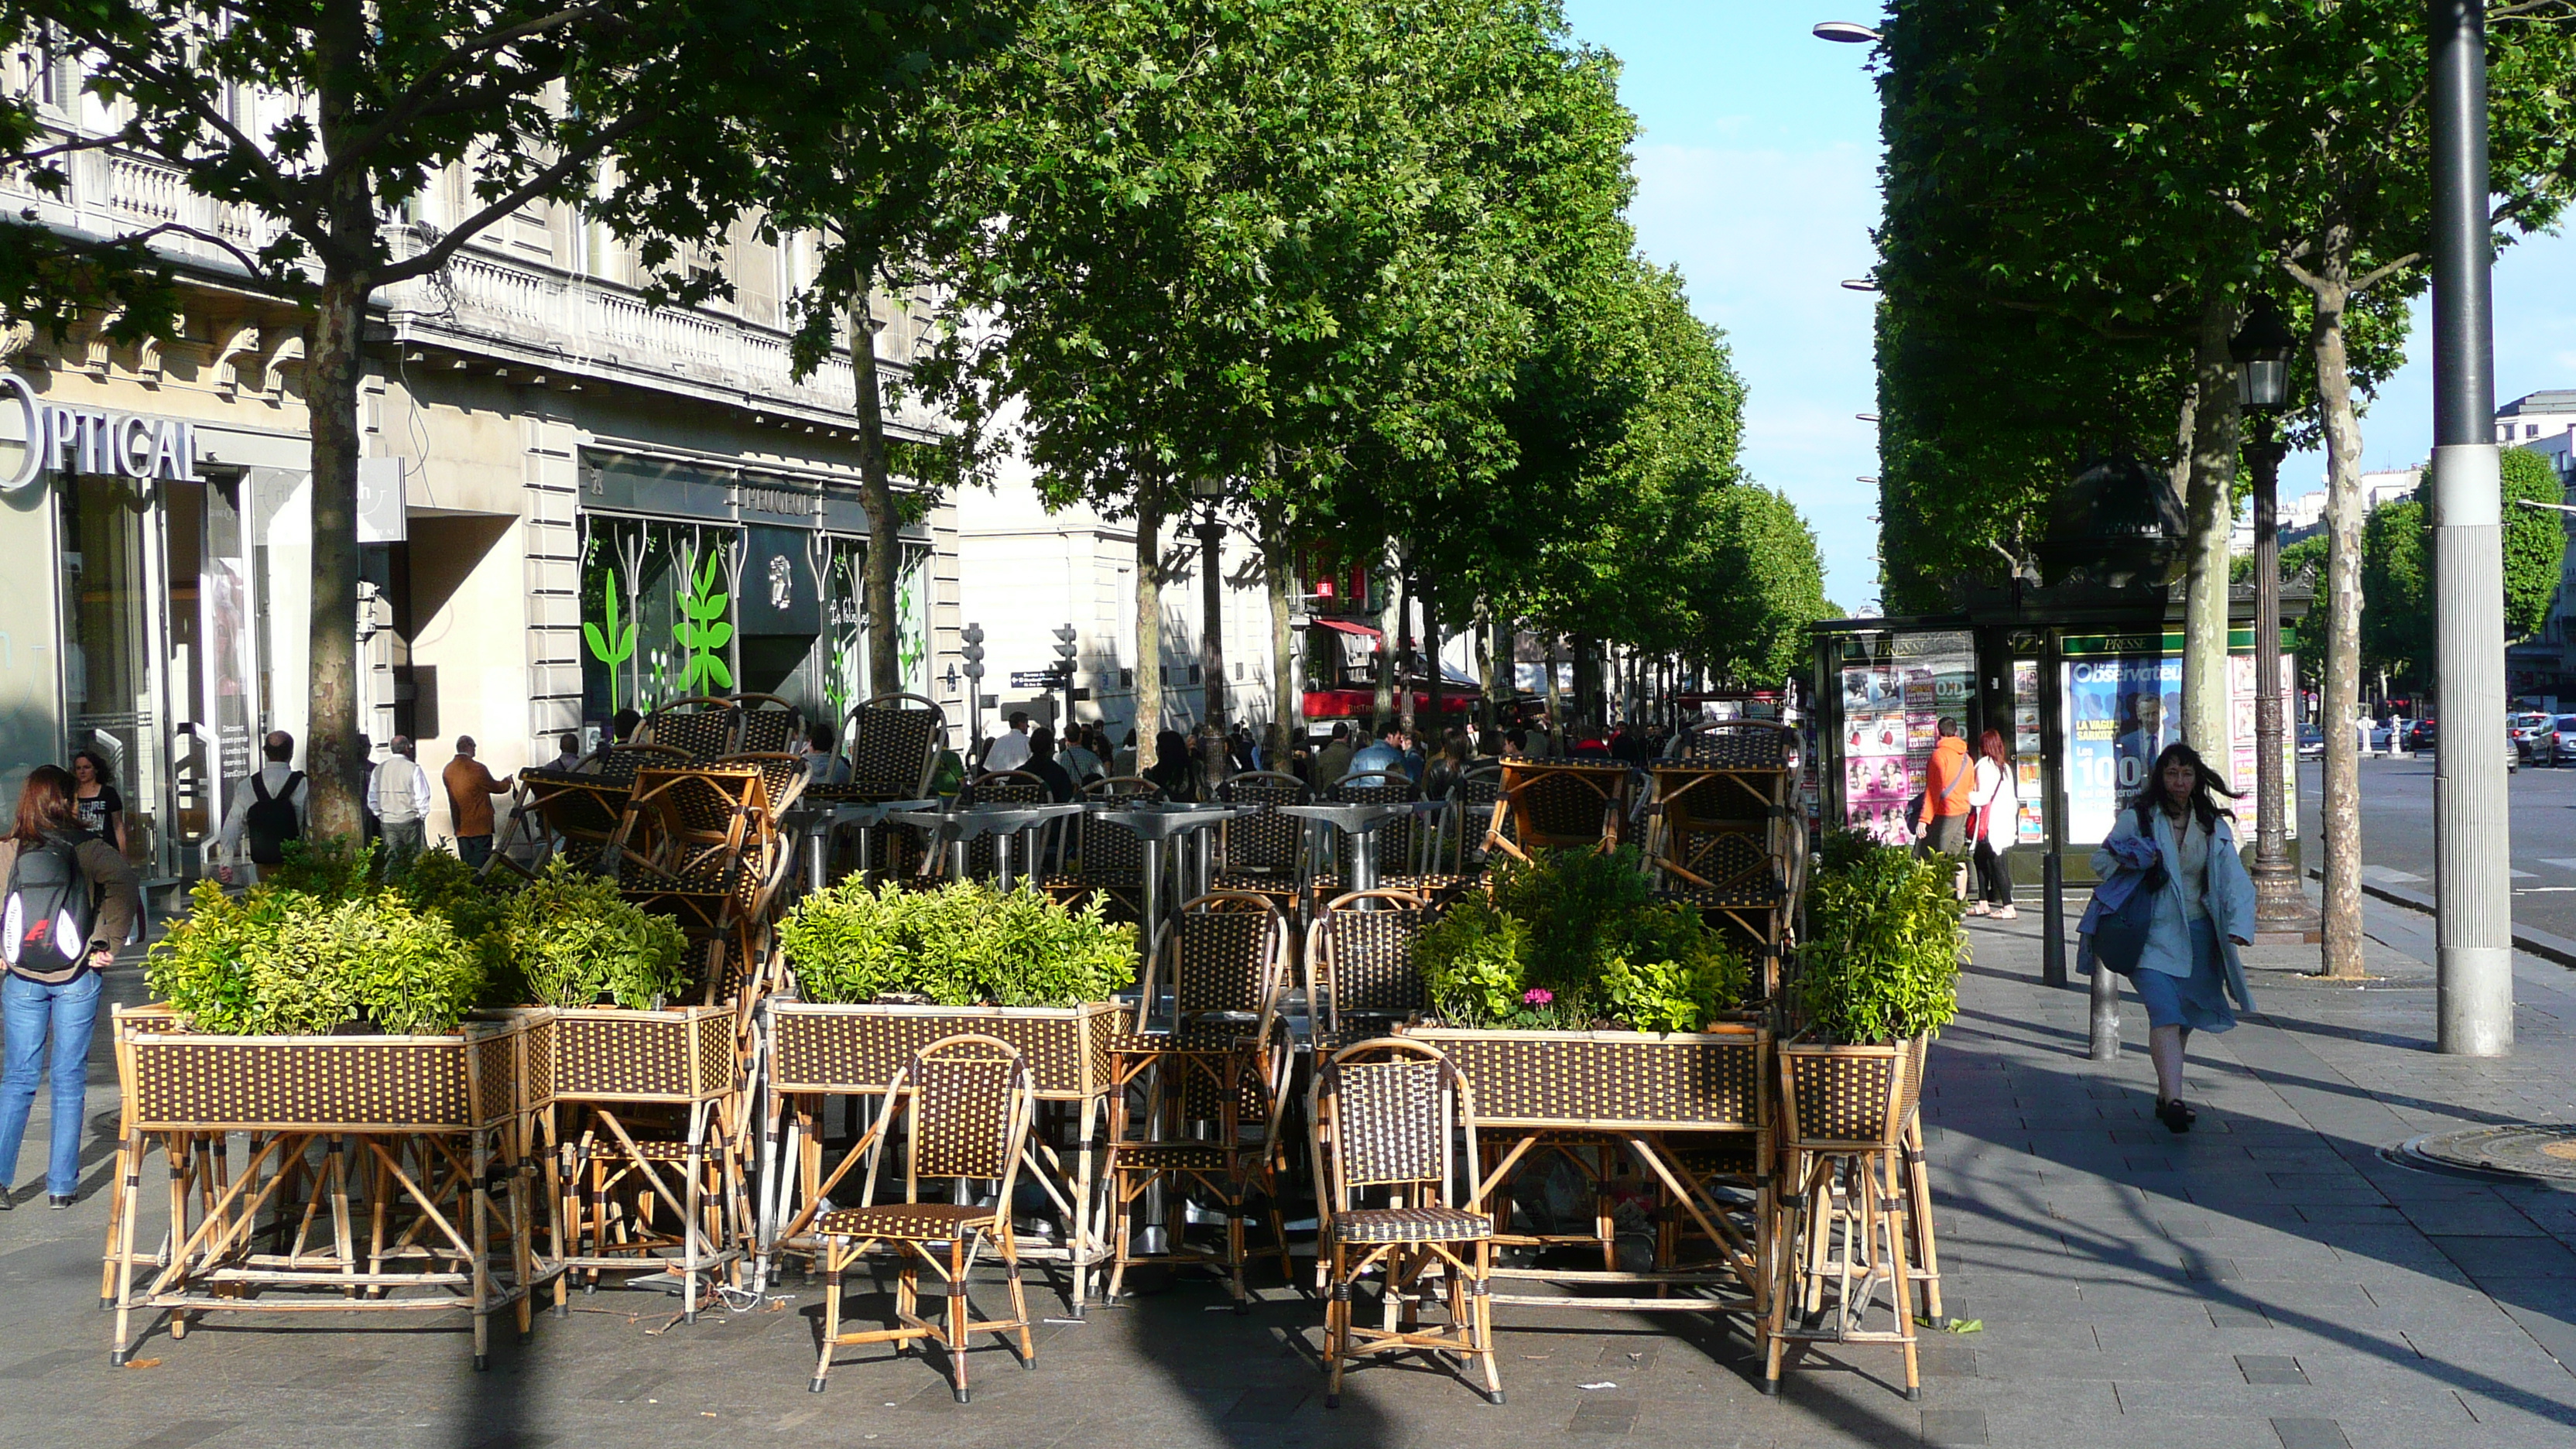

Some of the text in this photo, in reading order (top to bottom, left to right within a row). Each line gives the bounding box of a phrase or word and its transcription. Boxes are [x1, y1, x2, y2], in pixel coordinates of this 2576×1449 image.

[1877, 641, 1927, 656] PRESSE
[2104, 638, 2147, 650] PRESSE
[2073, 663, 2183, 683] Observateu
[1348, 704, 1375, 712] BISTR
[2076, 719, 2119, 731] LA VAGUE
[2076, 730, 2117, 742] SARKOZY
[2077, 746, 2094, 757] Les
[2077, 756, 2141, 786] 100
